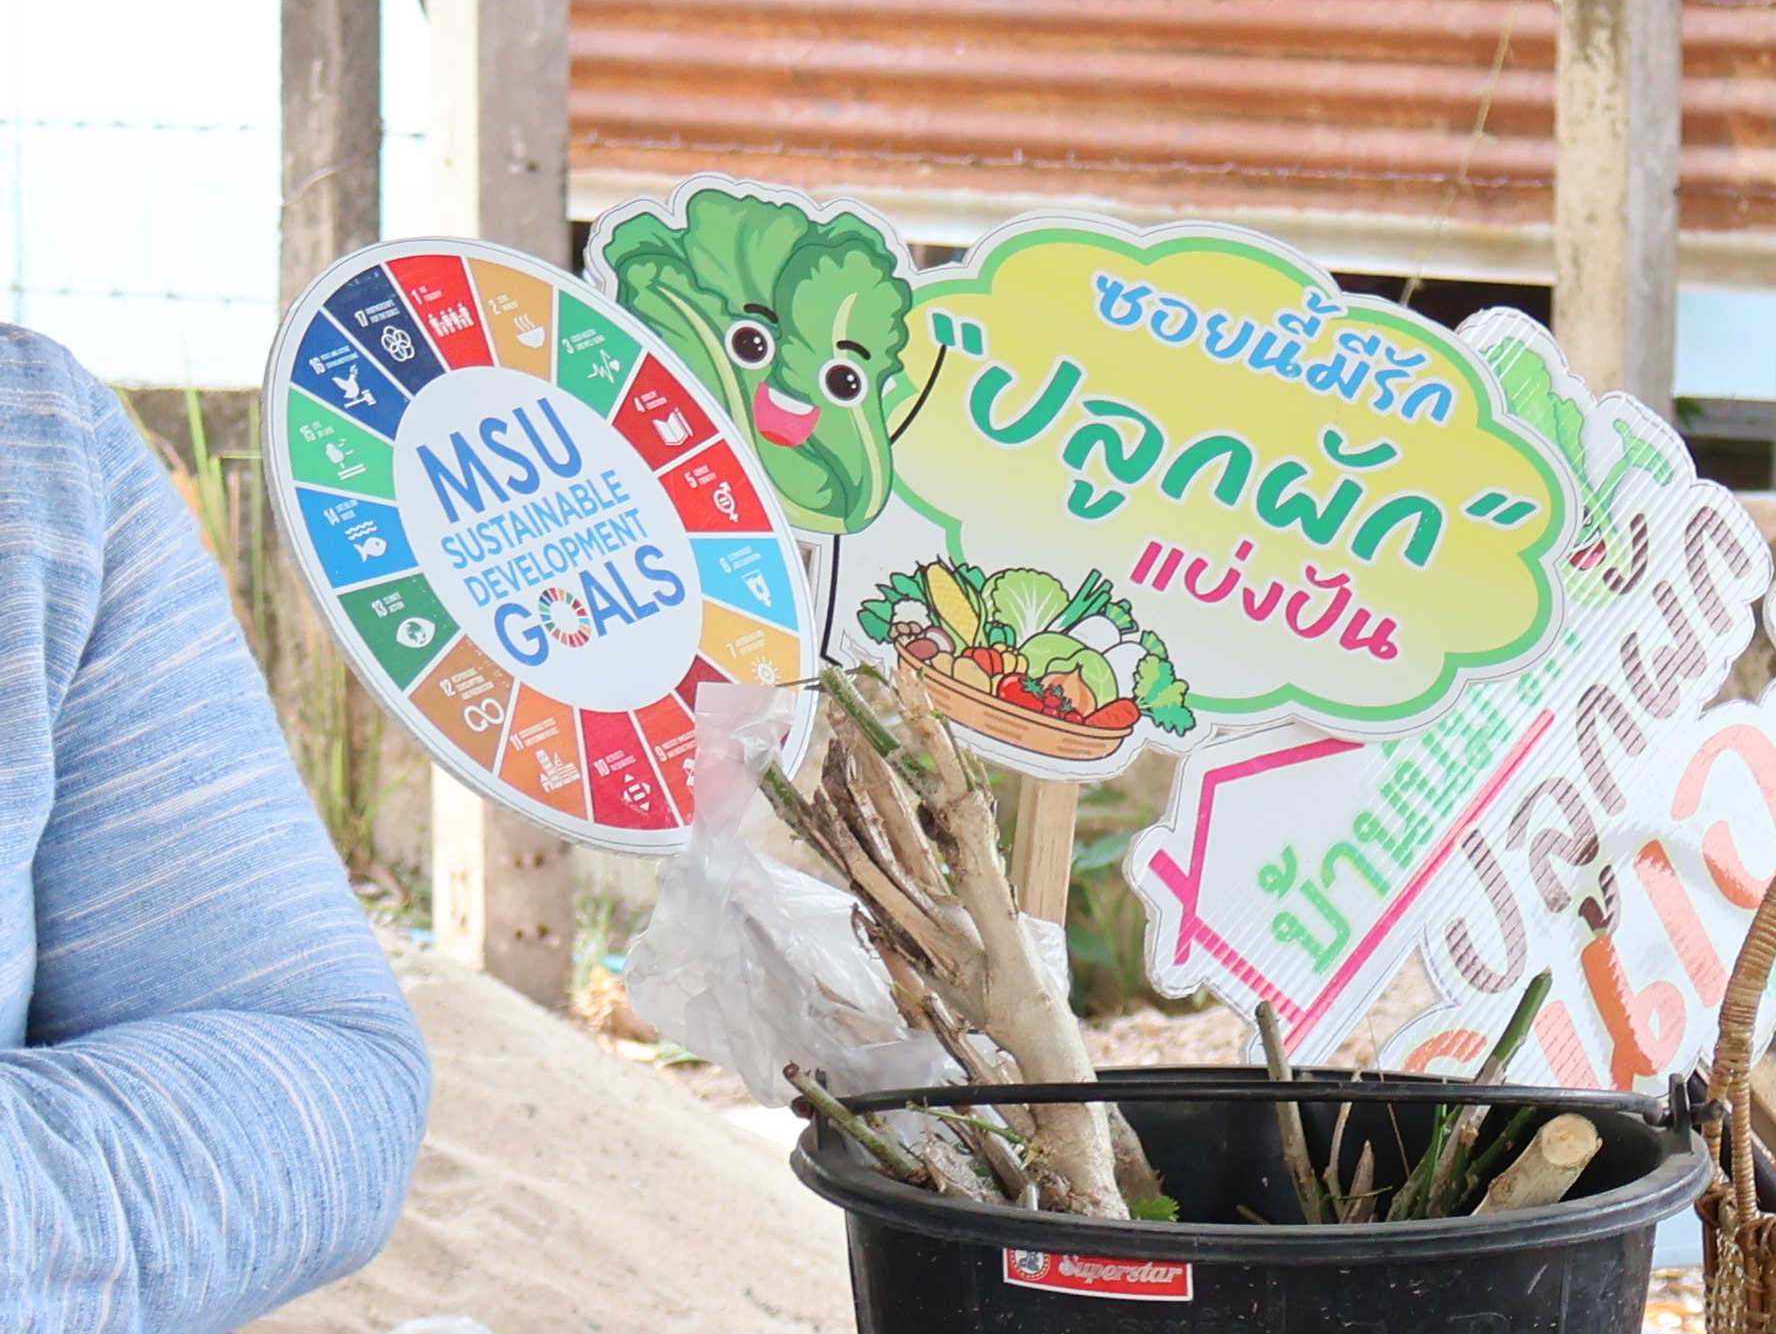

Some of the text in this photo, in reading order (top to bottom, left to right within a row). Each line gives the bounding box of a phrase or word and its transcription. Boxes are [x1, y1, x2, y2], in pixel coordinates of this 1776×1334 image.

[1096, 272, 1453, 424] ซอยนี้มีรัก
[416, 397, 582, 524] MSU
[441, 470, 630, 569] SUSTAINABLE
[463, 508, 648, 607] DEVELOPMENT
[494, 544, 685, 667] GOALS
[1129, 540, 1399, 661] แบ่งปัน
[1058, 1254, 1183, 1284] Superstar
